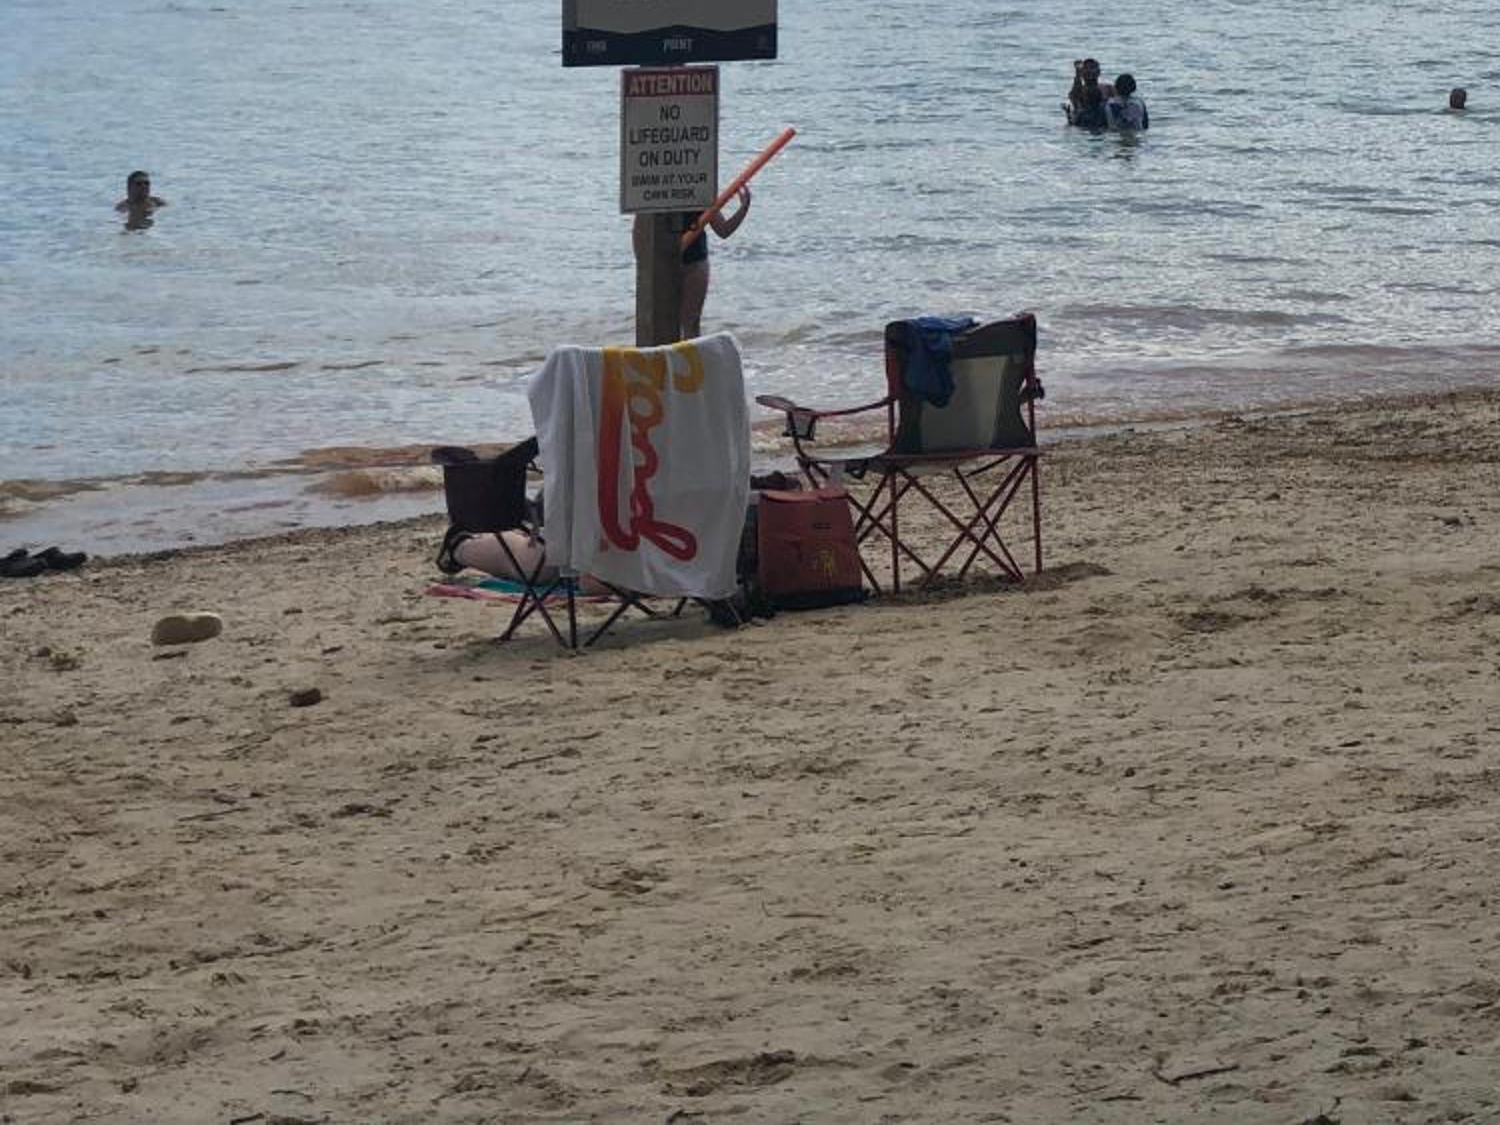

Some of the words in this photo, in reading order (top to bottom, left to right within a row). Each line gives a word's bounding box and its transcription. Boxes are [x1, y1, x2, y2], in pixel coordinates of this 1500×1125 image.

[629, 73, 713, 95] ATTENTION
[659, 105, 681, 120] NO
[629, 127, 710, 144] LIFEGUARD
[639, 151, 658, 167] ON
[664, 149, 701, 165] DUTY
[662, 175, 677, 186] AT
[678, 173, 707, 184] YOUR
